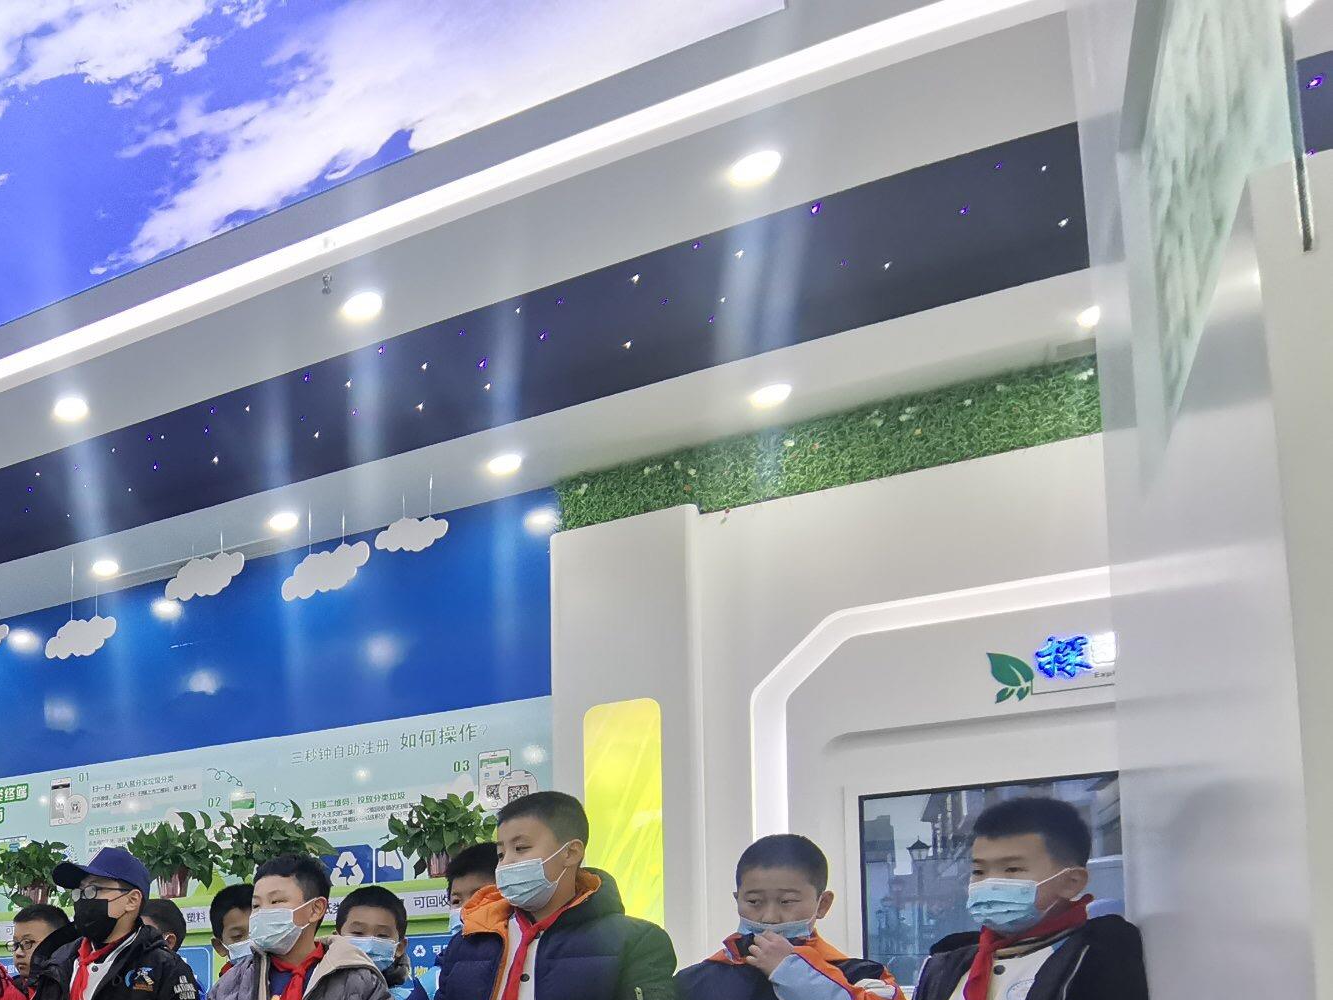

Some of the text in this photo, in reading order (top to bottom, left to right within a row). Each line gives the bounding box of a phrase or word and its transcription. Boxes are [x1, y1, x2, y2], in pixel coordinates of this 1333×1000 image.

[291, 740, 390, 765] 三秒钟自助注册
[453, 760, 471, 772] 03
[79, 772, 90, 782] 01
[208, 796, 221, 808] 02
[413, 895, 451, 908] 可回收
[187, 911, 206, 923] 塑料
